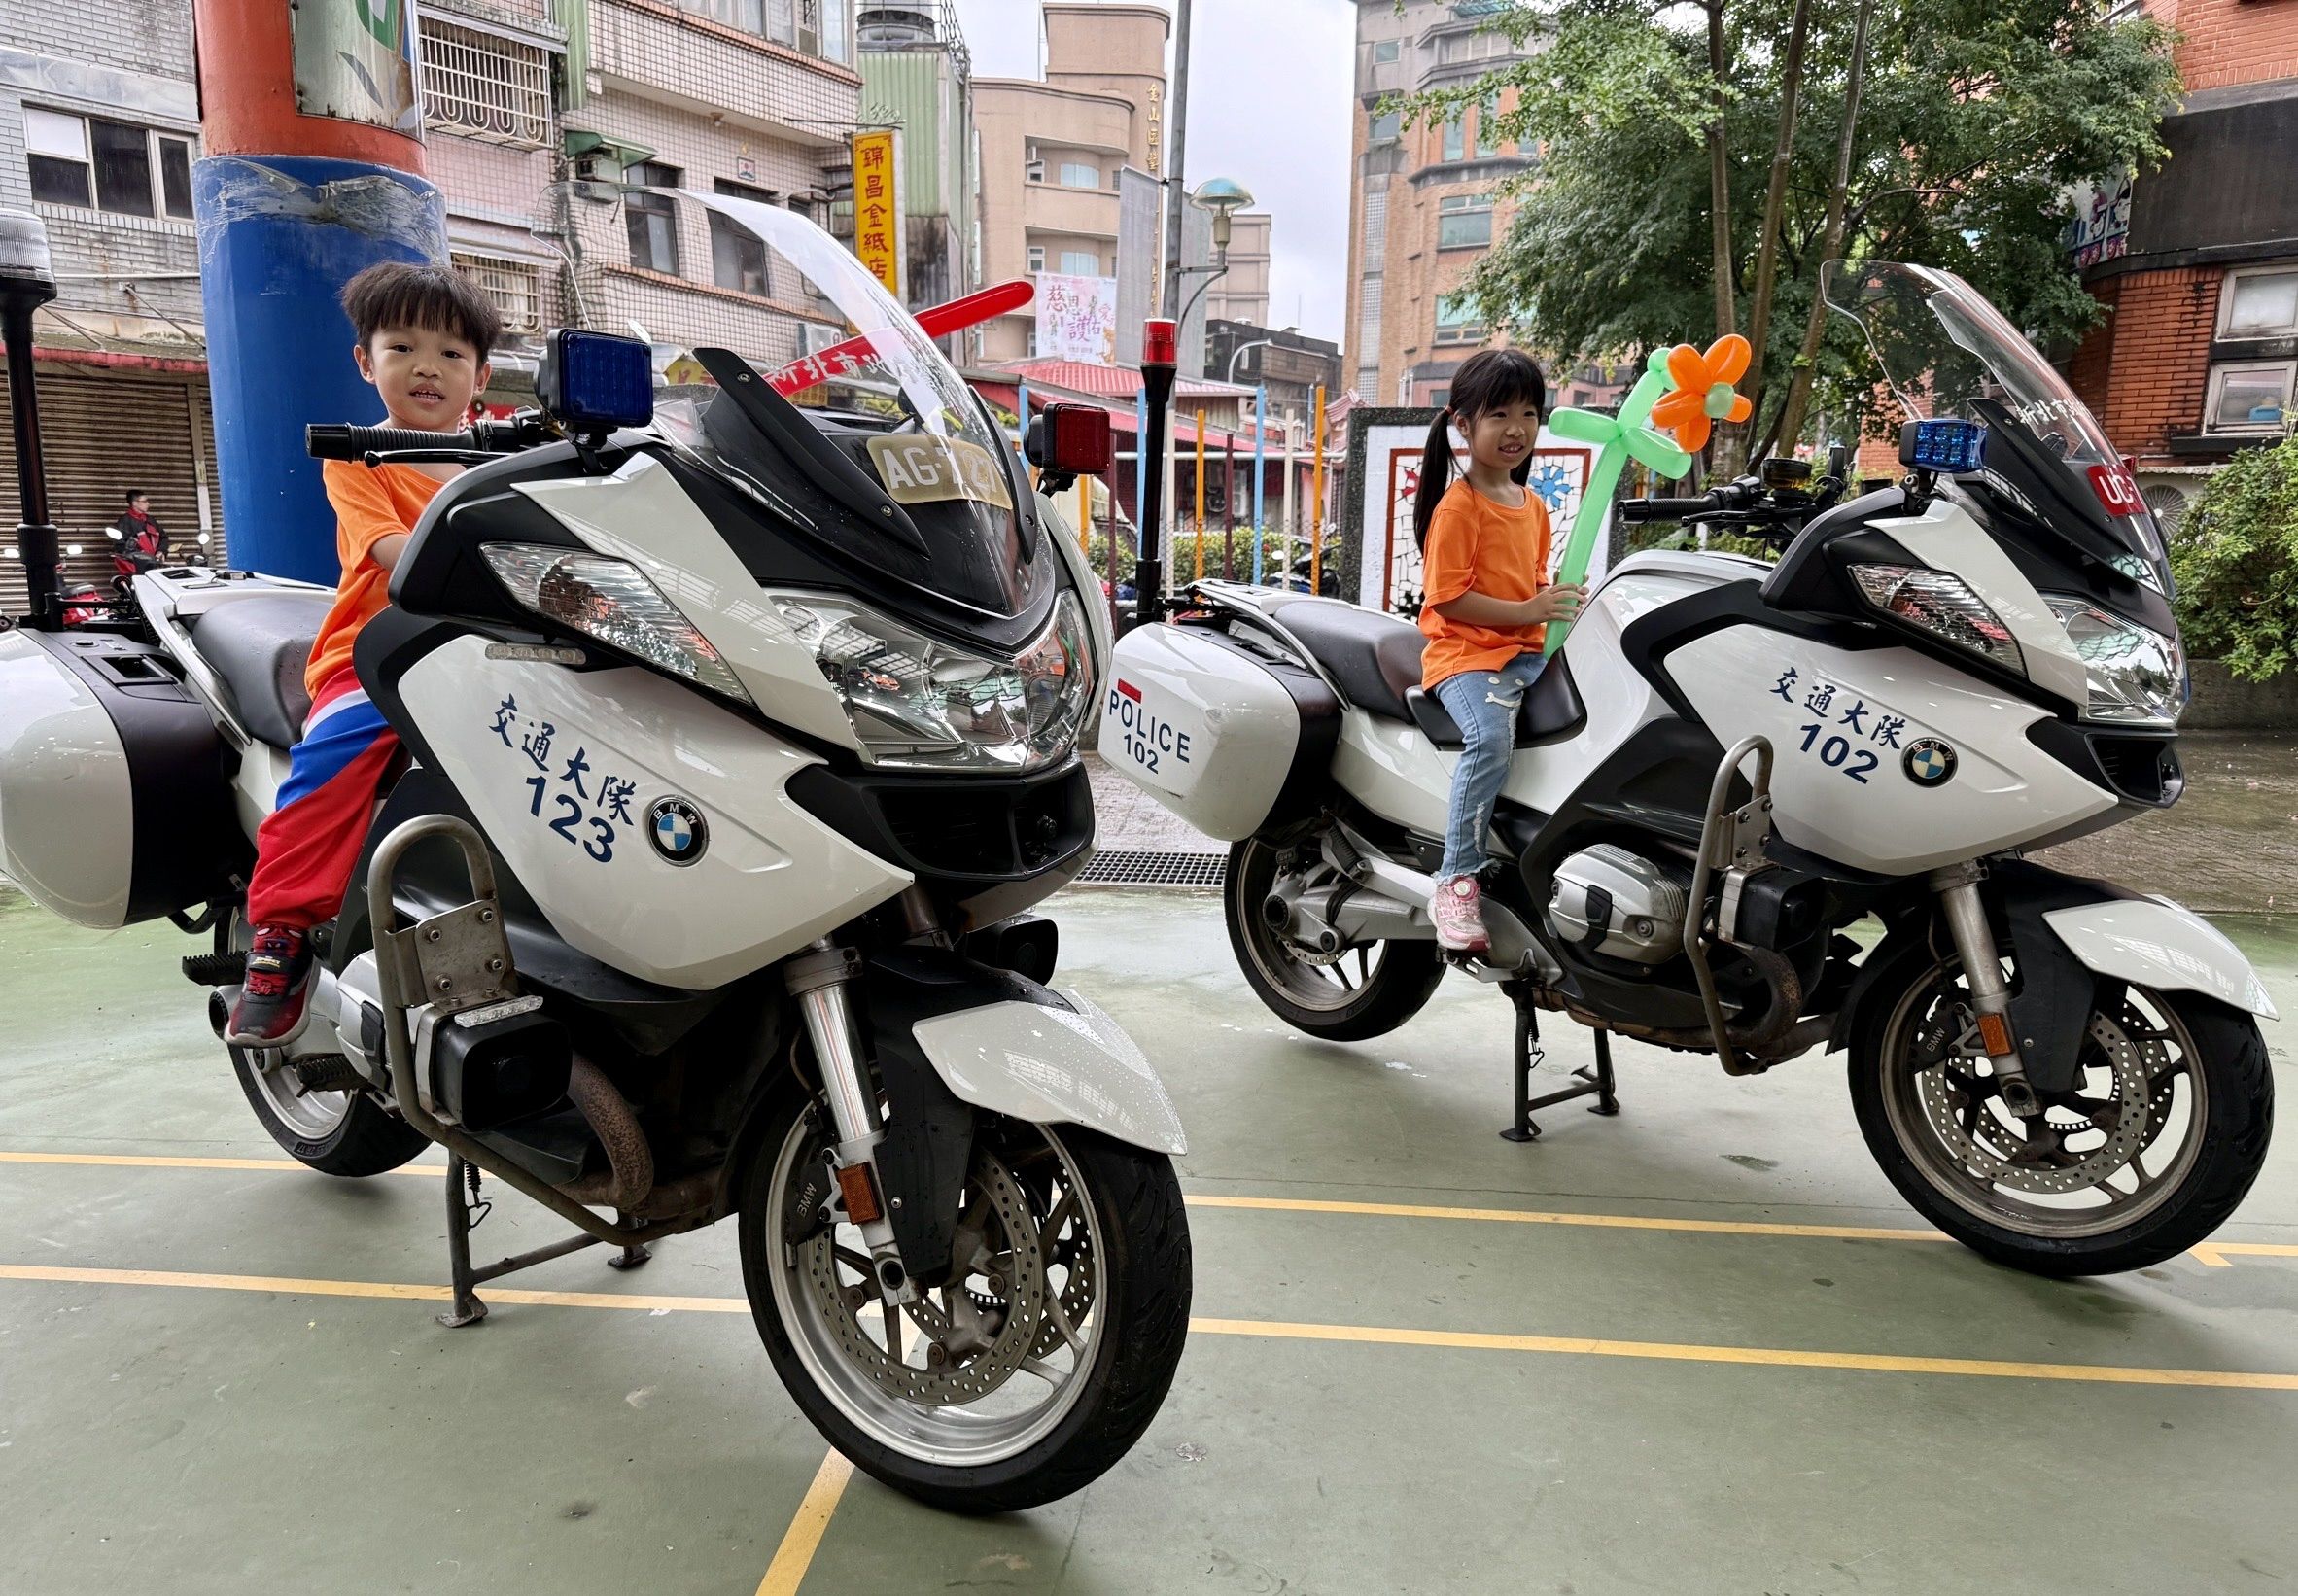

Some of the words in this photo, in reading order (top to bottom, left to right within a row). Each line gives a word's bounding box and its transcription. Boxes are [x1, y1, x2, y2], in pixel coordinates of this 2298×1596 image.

[861, 146, 889, 281] 錦昌金紙店
[1109, 689, 1190, 764] POLICE
[1769, 667, 1906, 749] 交通大隊
[489, 693, 636, 826] 交通大隊
[1124, 734, 1159, 775] 102
[1799, 723, 1879, 784] 102
[526, 776, 615, 863] 123
[1926, 1026, 1945, 1052] BMW
[797, 1182, 817, 1218] BMW
